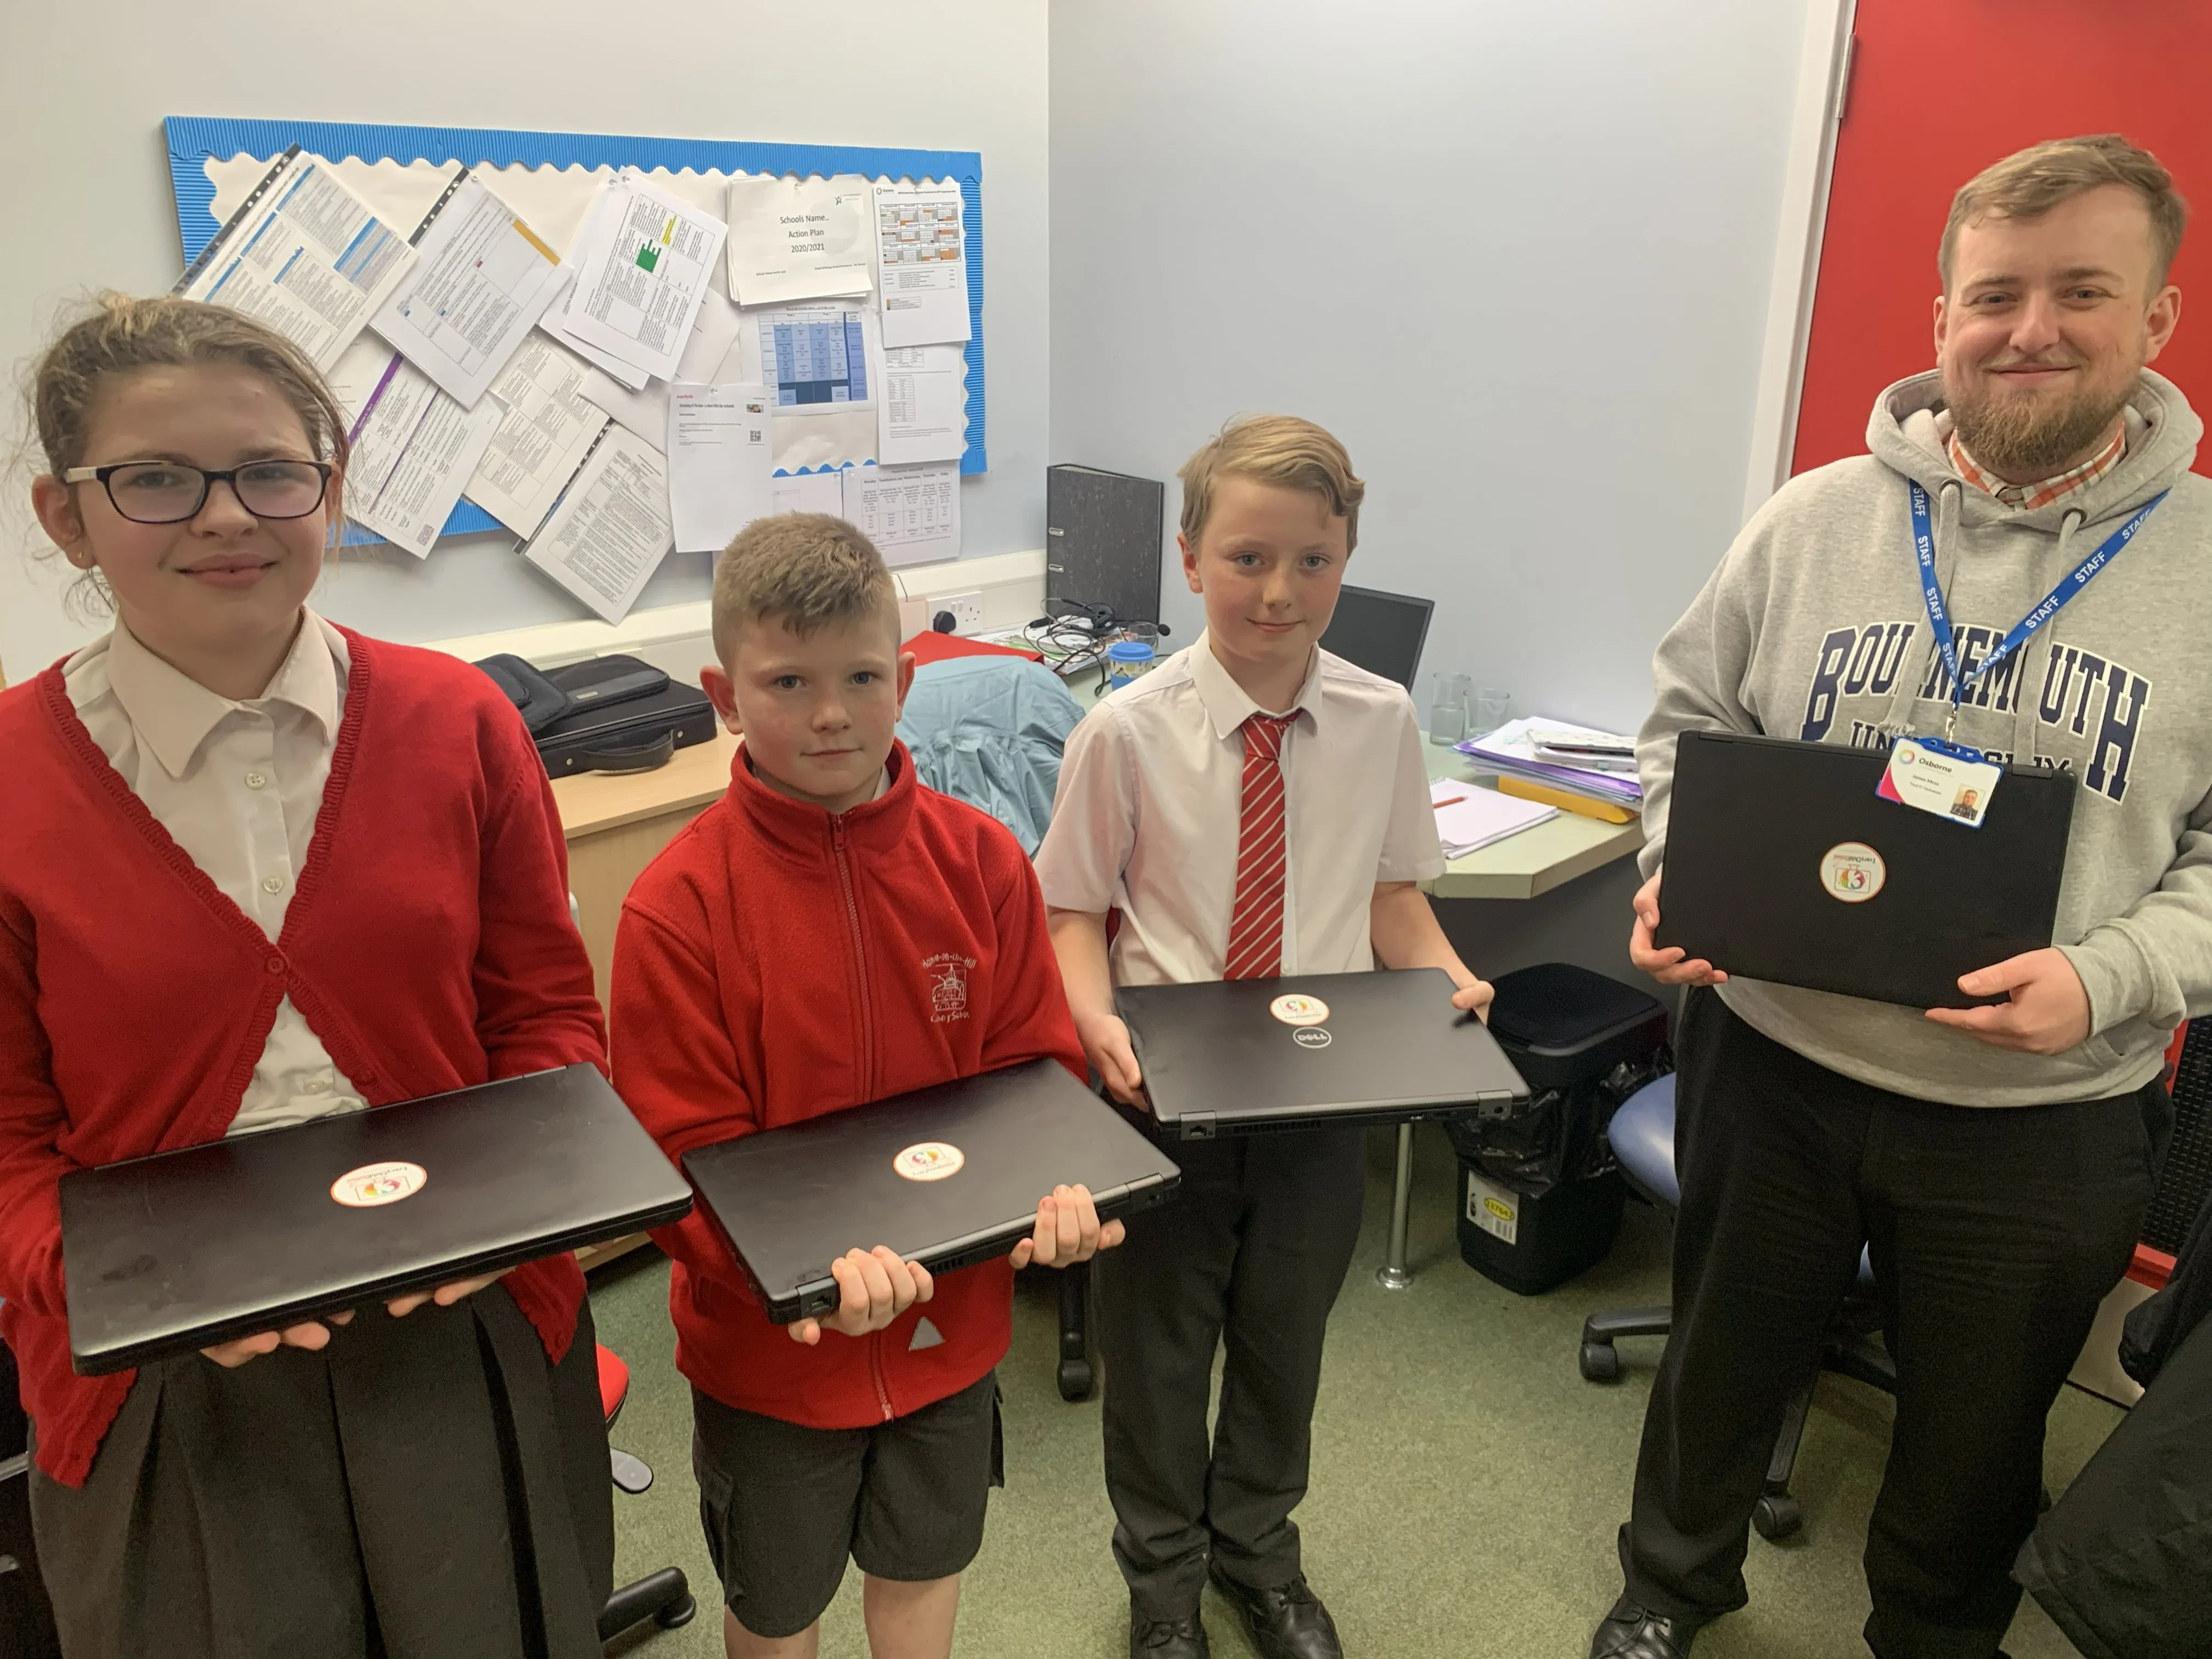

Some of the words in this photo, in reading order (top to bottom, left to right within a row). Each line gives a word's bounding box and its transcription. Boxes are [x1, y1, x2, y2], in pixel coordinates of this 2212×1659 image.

[780, 215, 804, 224] Schools
[788, 230, 809, 238] Action
[810, 228, 825, 236] Plan
[791, 243, 825, 253] 2020/2021
[1913, 488, 1926, 517] STAFF
[1918, 535, 1931, 567] STAFF
[2075, 551, 2107, 583] STAFF
[1927, 587, 1943, 621] STAFF
[2025, 595, 2059, 629] STAFF
[1943, 642, 1957, 679] STAFF
[1801, 622, 2152, 805] BOUNEMUTH
[1919, 758, 1952, 773] Osborne
[1297, 1033, 1328, 1041] DELL
